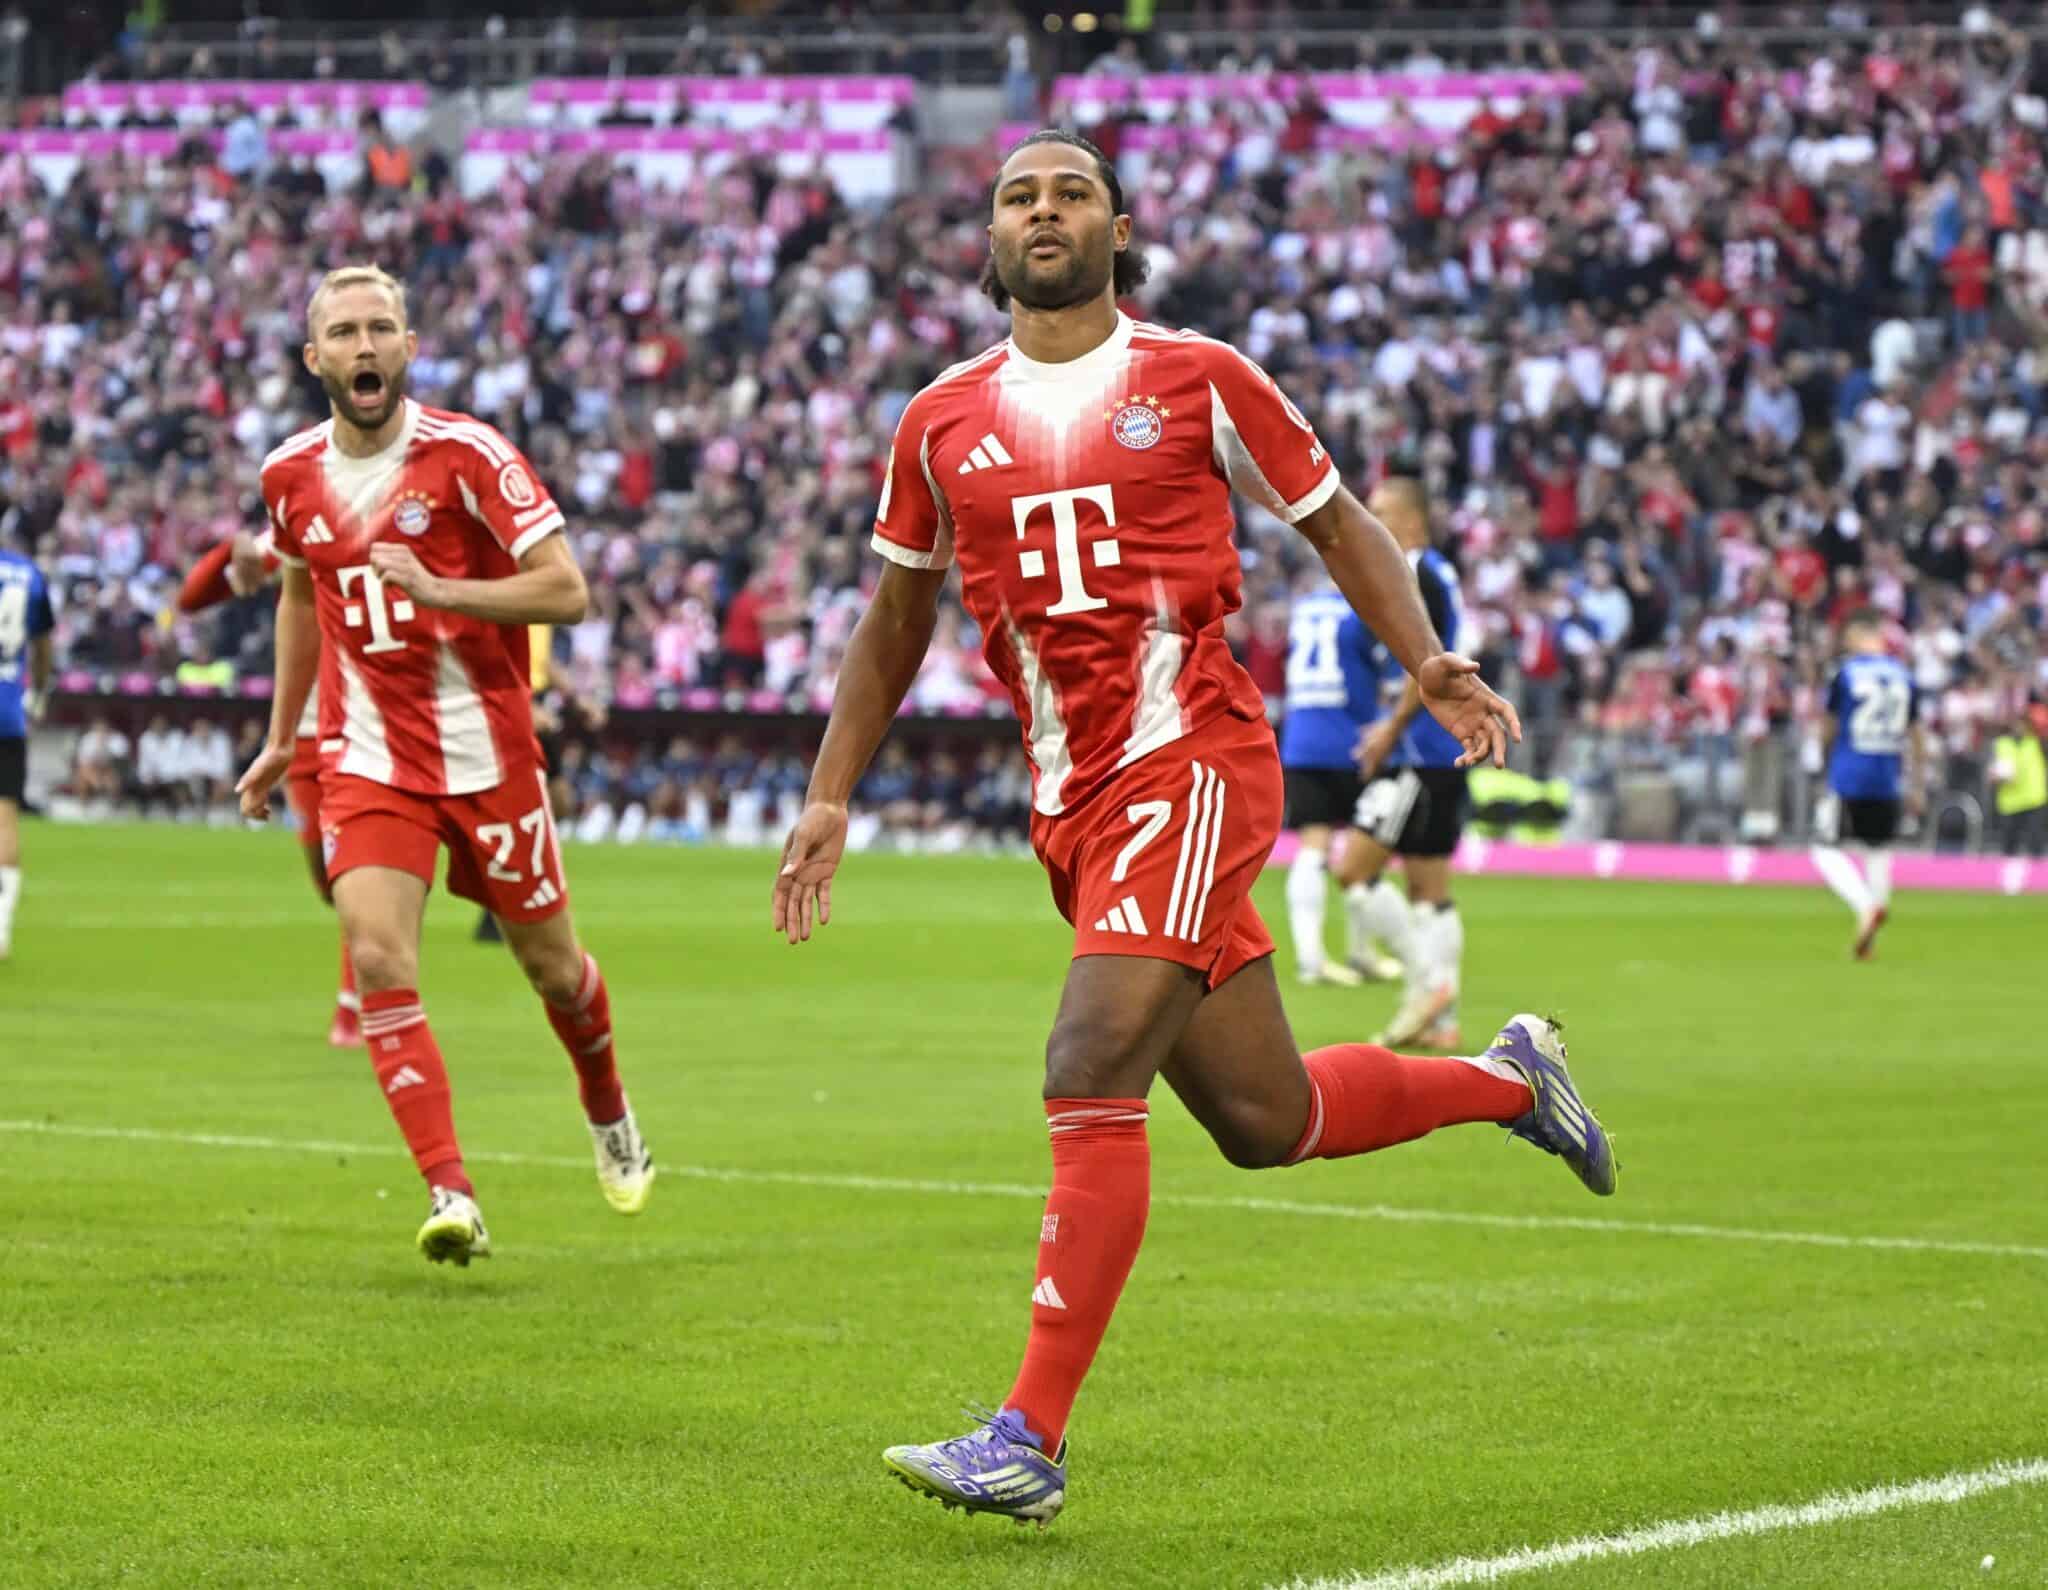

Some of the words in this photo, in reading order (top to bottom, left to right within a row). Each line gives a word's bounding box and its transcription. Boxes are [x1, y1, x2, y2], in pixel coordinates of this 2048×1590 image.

[1012, 484, 1121, 616] T
[476, 811, 545, 883] 27
[1111, 800, 1172, 882] 7
